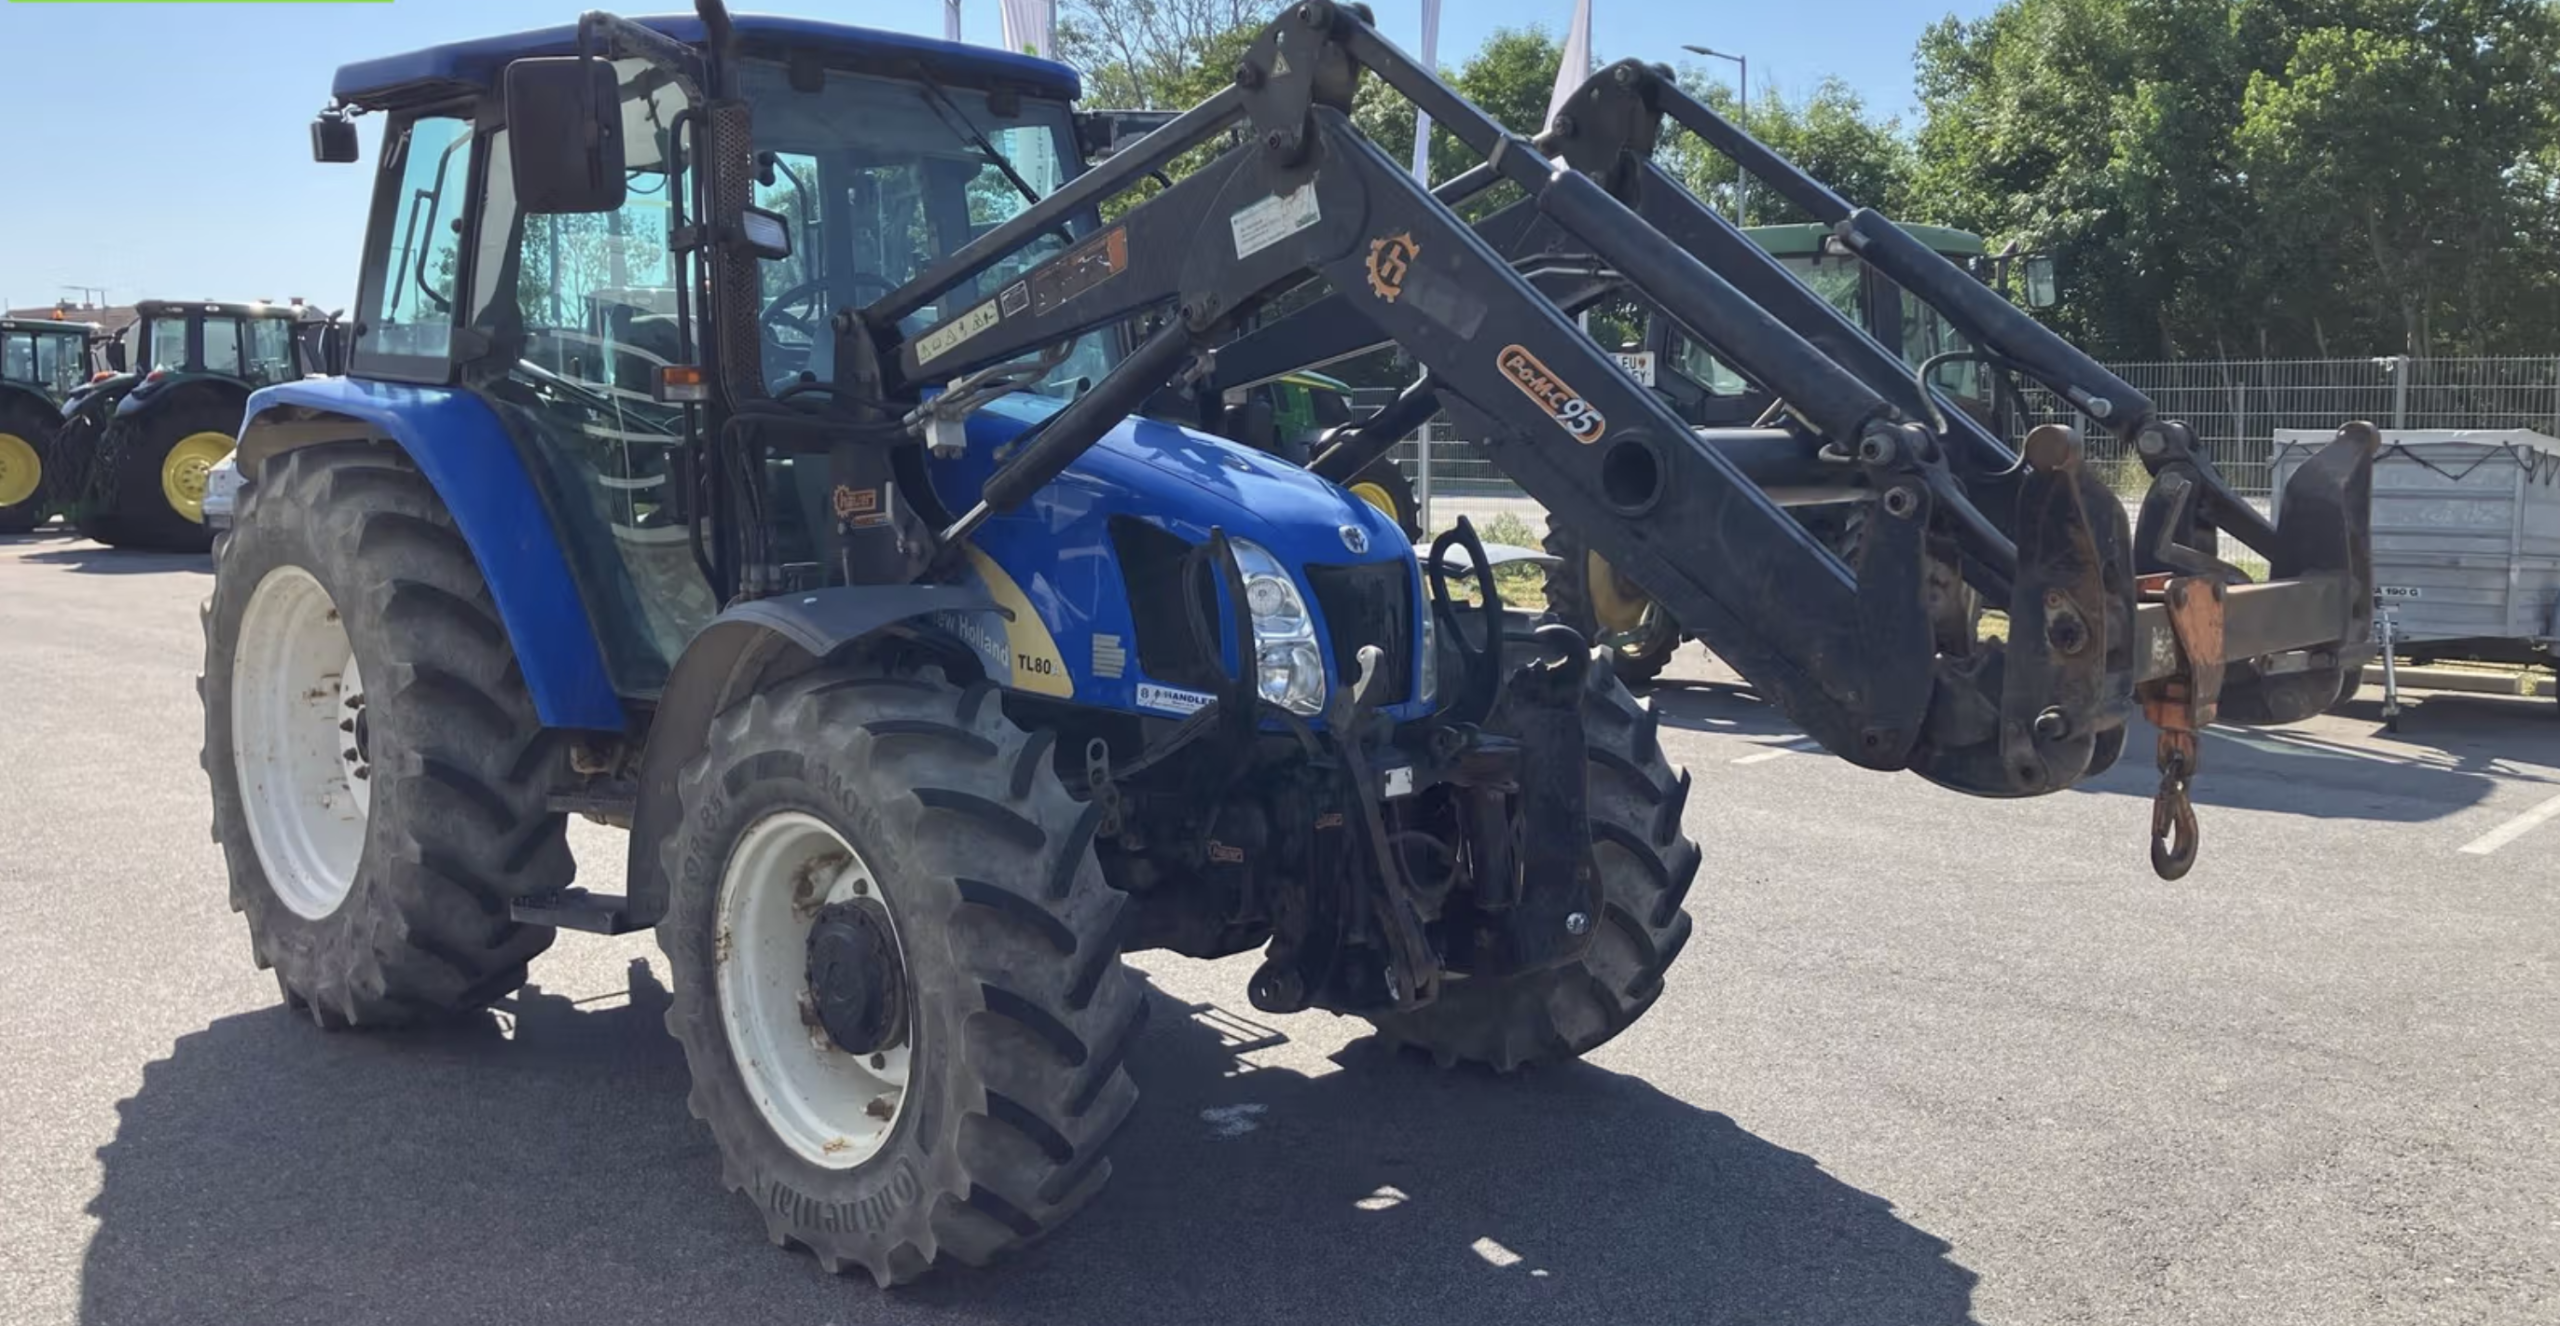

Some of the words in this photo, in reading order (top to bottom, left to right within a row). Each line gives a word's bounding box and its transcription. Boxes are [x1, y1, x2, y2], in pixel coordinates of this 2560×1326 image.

[1622, 356, 1637, 369] EU
[1556, 398, 1602, 433] 95
[959, 614, 1010, 667] Holland
